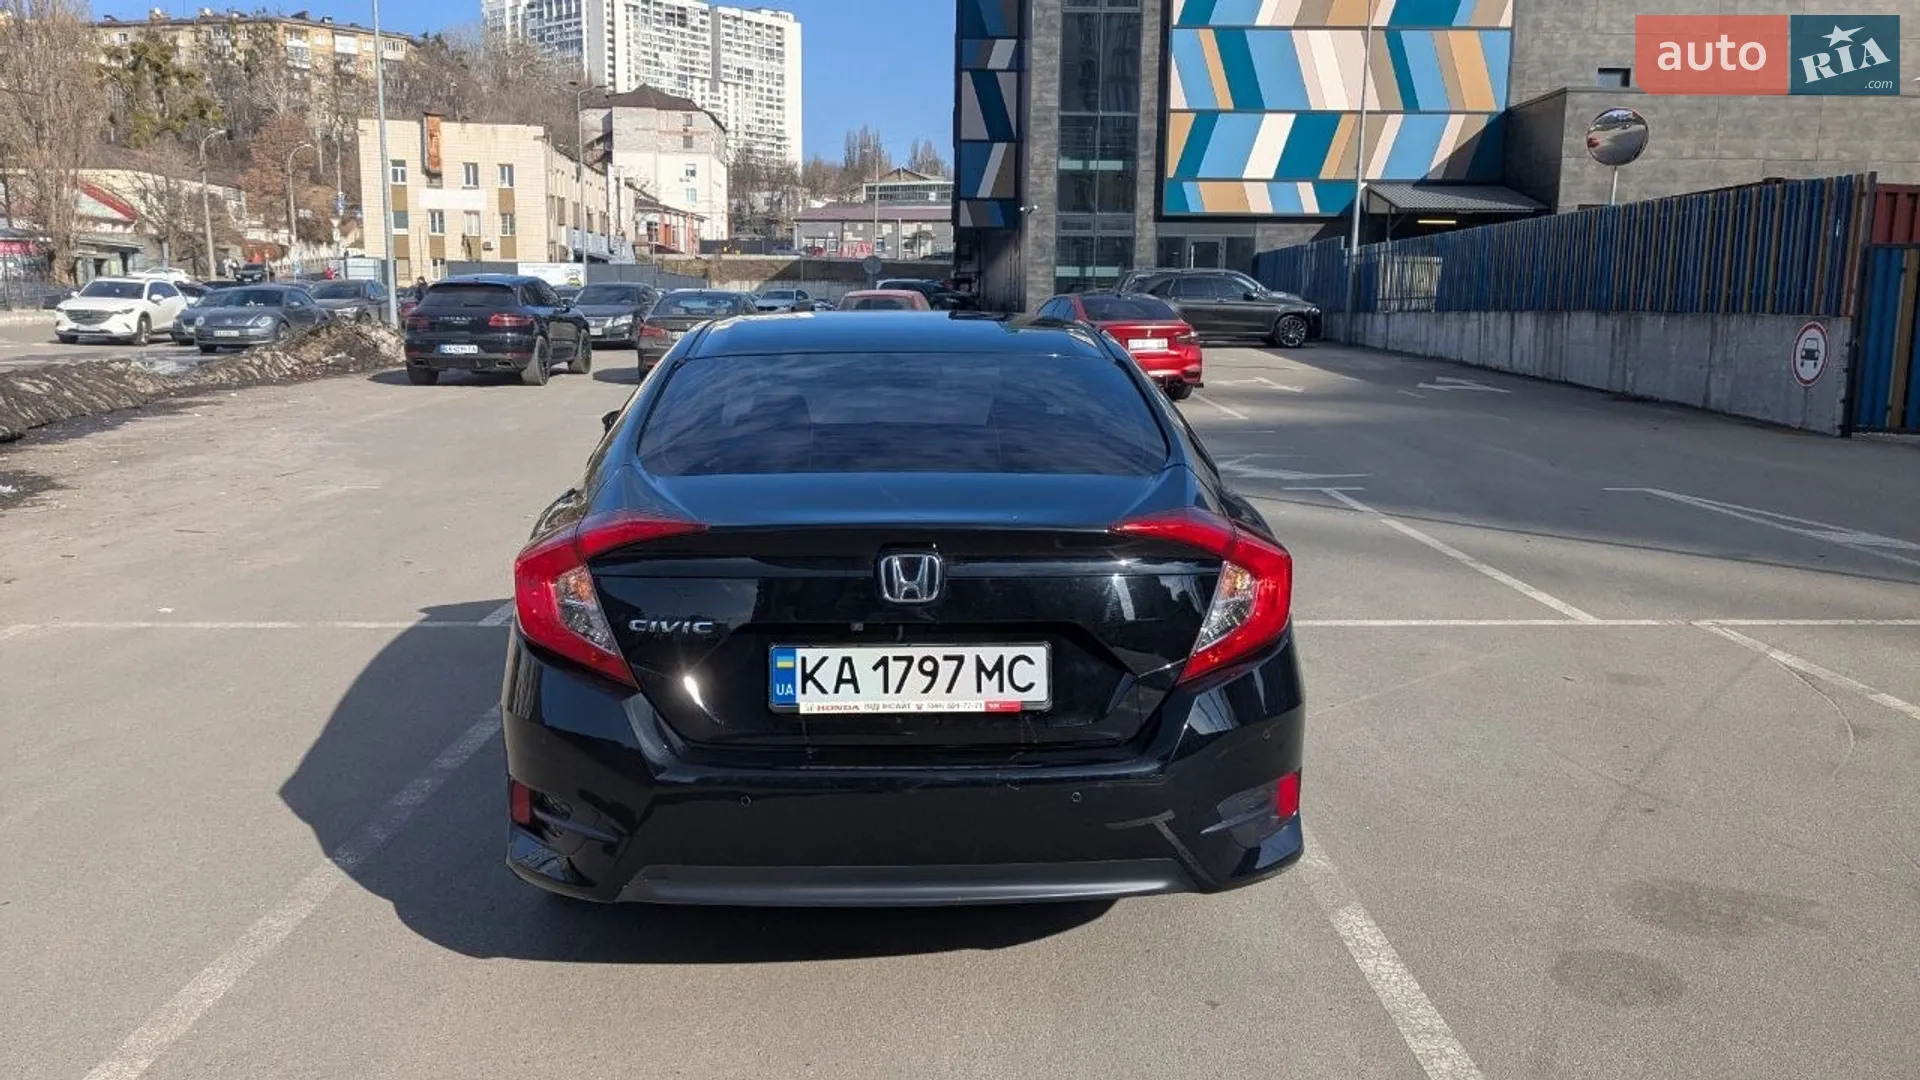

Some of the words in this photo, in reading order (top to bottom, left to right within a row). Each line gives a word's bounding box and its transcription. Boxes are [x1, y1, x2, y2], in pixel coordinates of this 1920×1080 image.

[628, 619, 713, 634] CIVIC
[801, 655, 861, 695] KA
[871, 654, 965, 695] 1797
[975, 653, 1036, 693] MC
[776, 684, 795, 696] UA
